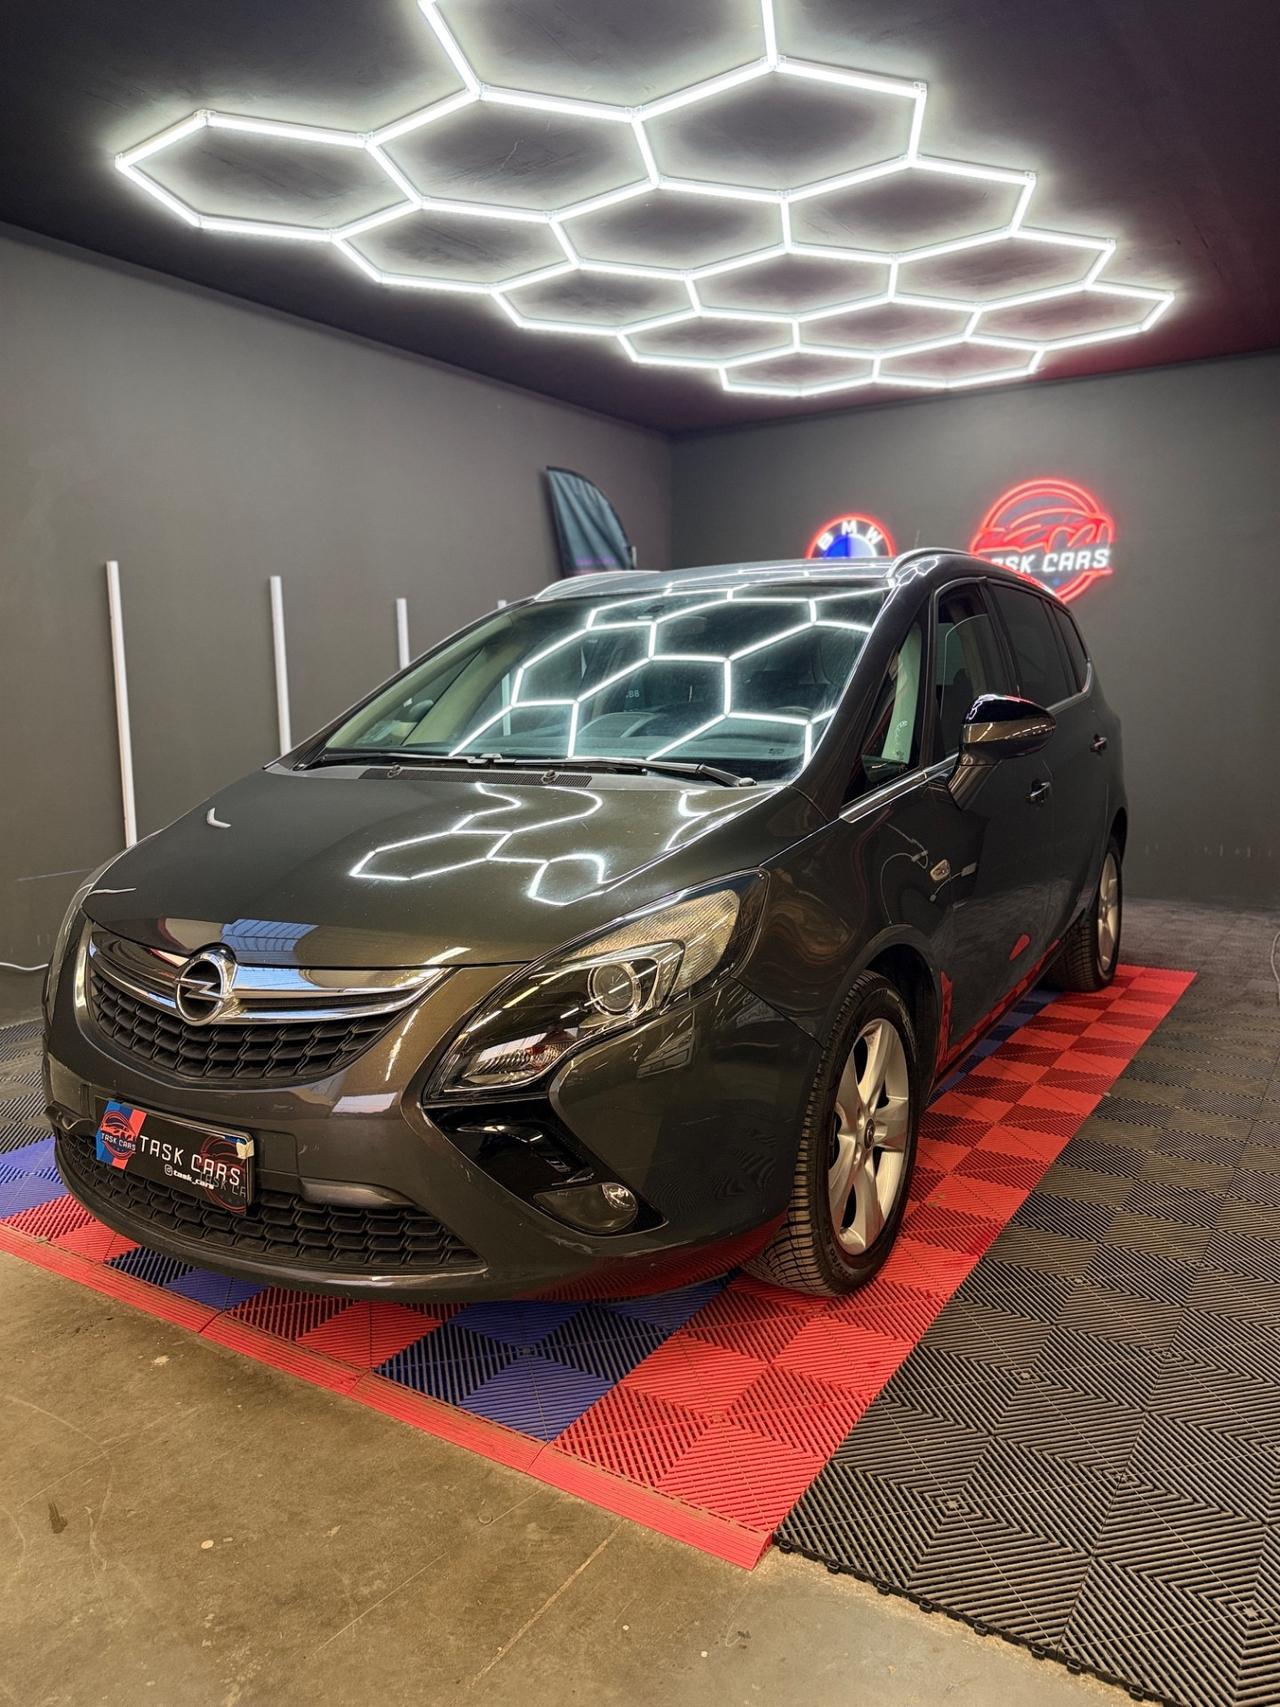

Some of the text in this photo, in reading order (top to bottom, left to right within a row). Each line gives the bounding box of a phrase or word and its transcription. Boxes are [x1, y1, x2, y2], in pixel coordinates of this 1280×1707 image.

[817, 520, 884, 551] BMW
[1042, 549, 1111, 573] CARS
[101, 1132, 136, 1151] TASK CARS
[140, 1135, 241, 1186] TASK CARS
